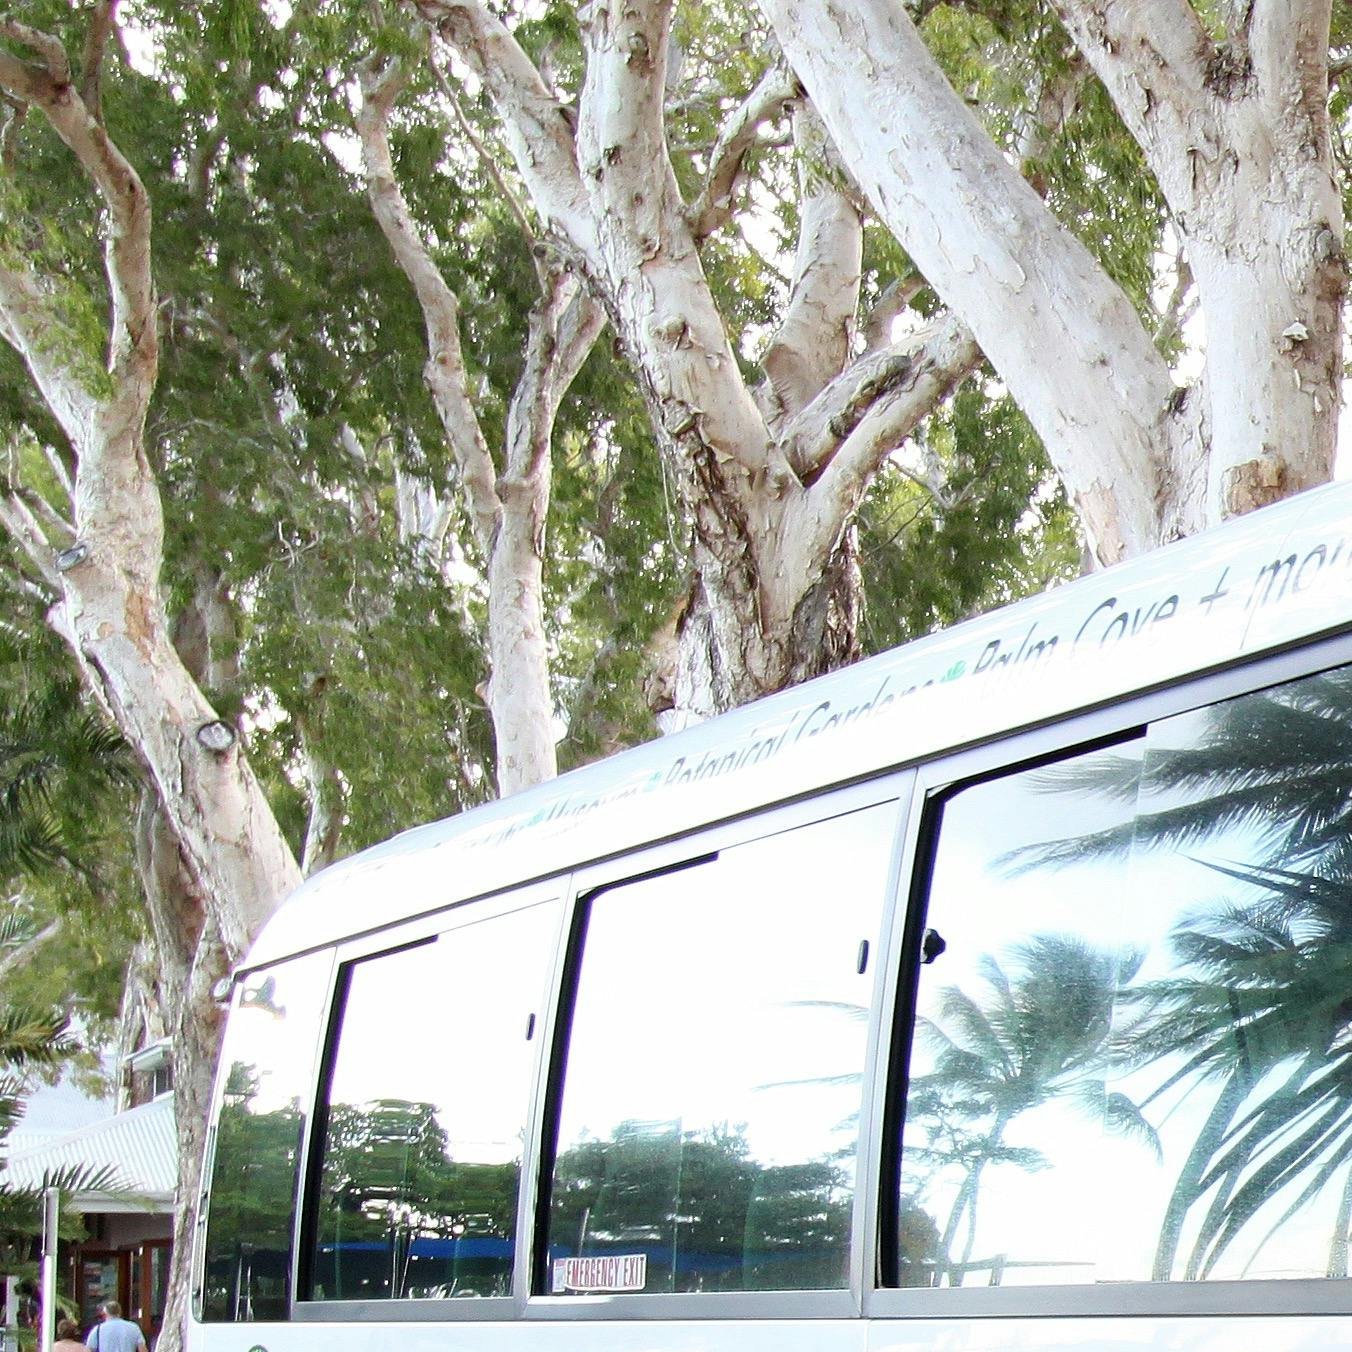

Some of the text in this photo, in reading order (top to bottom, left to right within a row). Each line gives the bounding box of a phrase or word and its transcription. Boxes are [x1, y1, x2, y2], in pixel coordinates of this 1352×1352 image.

[973, 623, 1059, 676] Palm
[1072, 594, 1180, 657] Cove
[1202, 567, 1230, 616] +
[566, 1257, 645, 1288] EMERGENCY EXIT
